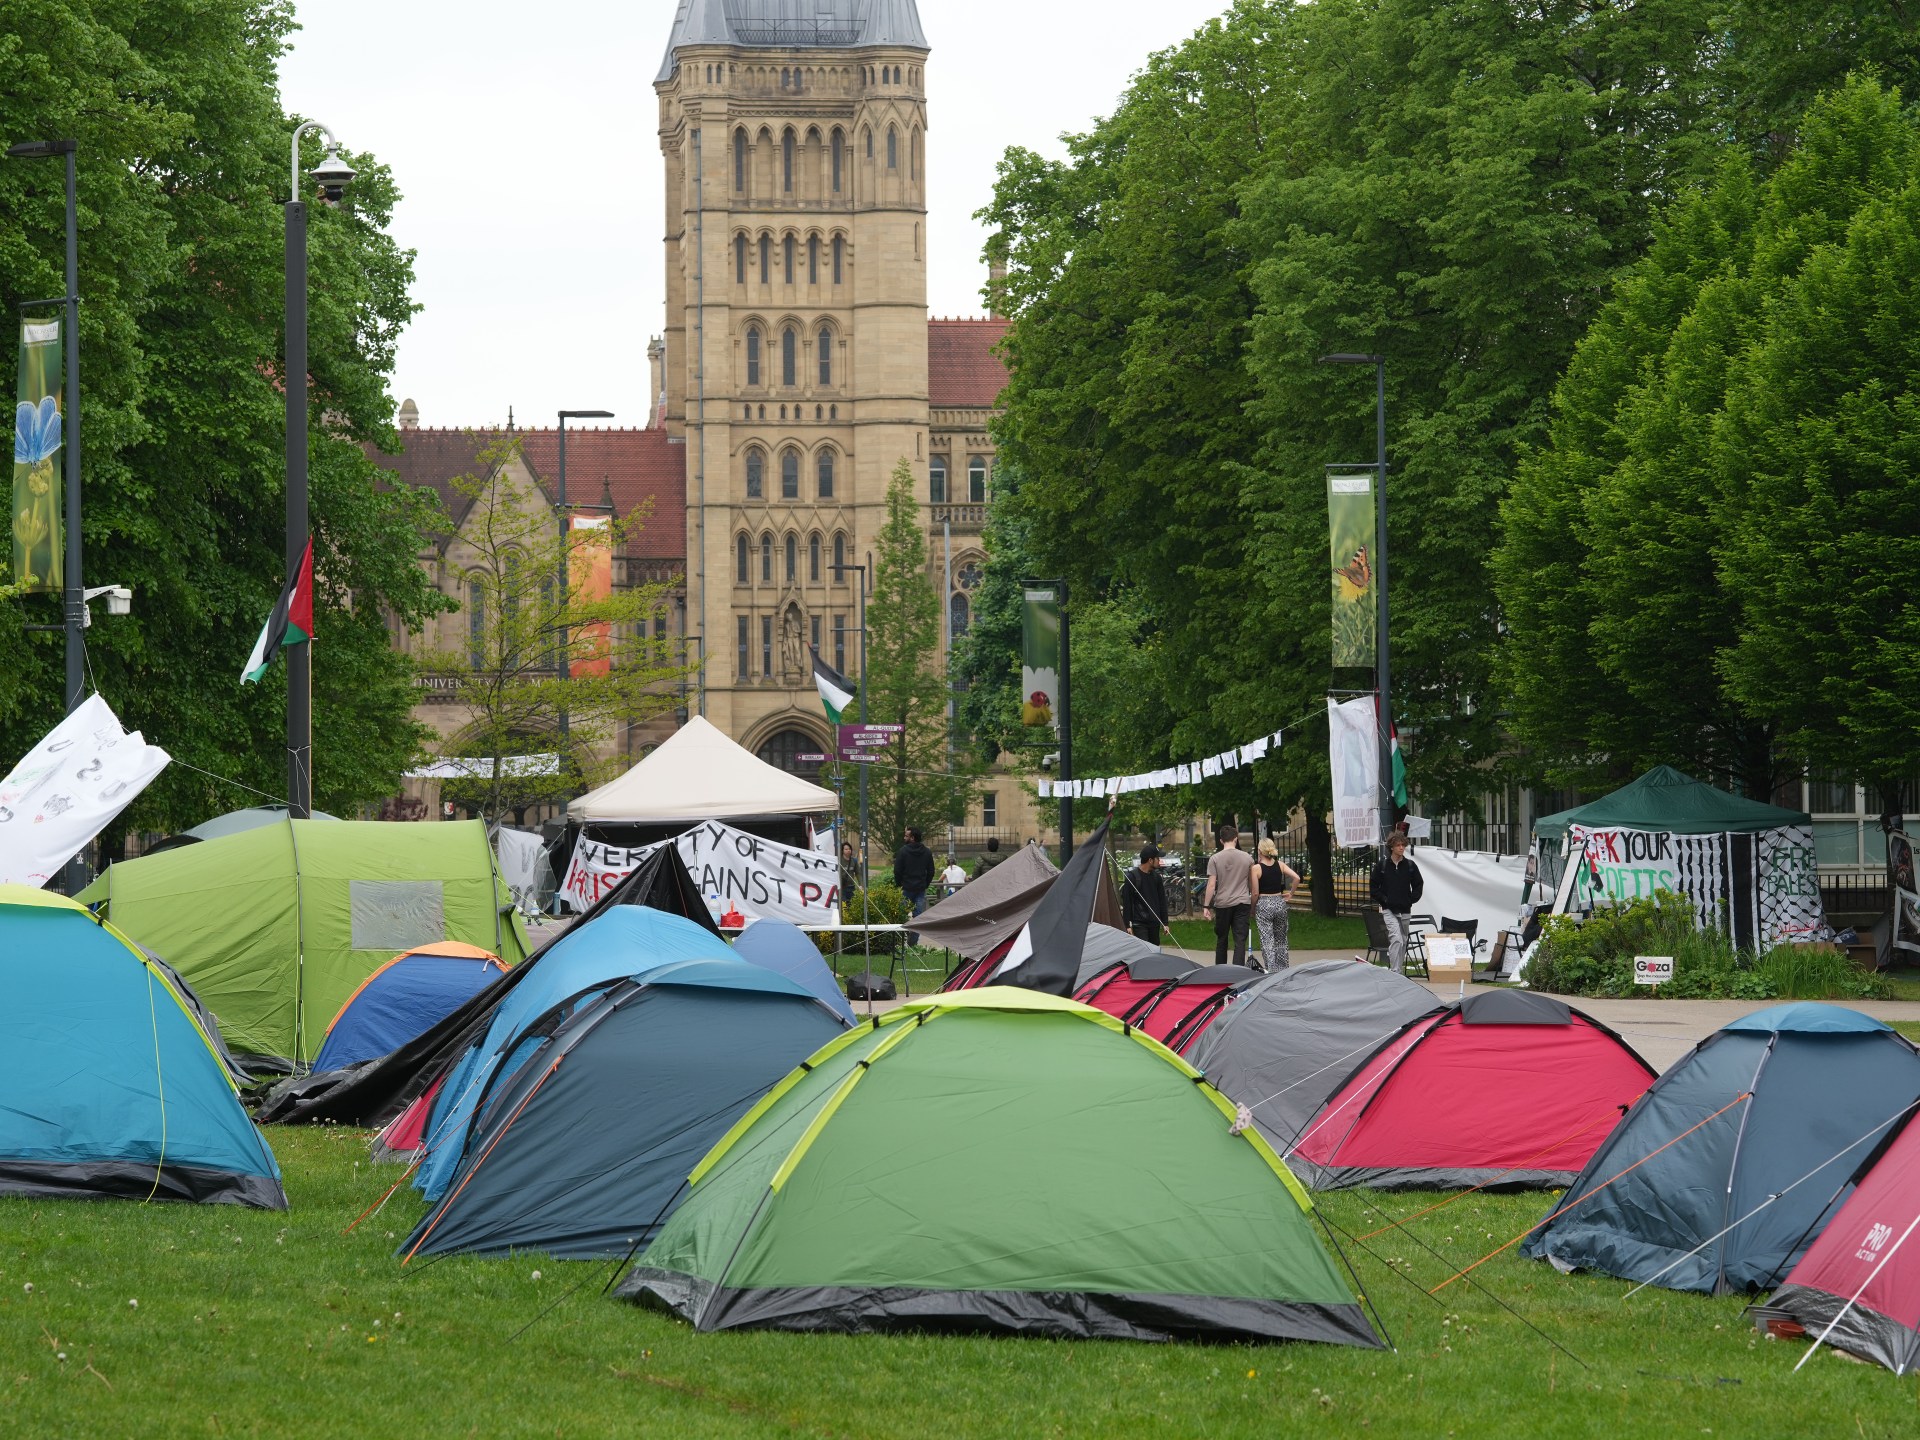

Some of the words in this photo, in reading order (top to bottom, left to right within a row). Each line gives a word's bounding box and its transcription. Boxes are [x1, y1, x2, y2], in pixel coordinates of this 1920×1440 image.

[735, 835, 765, 862] OF
[1620, 831, 1673, 864] YOUR
[1636, 961, 1670, 972] Gza
[1861, 1222, 1892, 1251] PRO
[1855, 1248, 1876, 1262] ACTION
